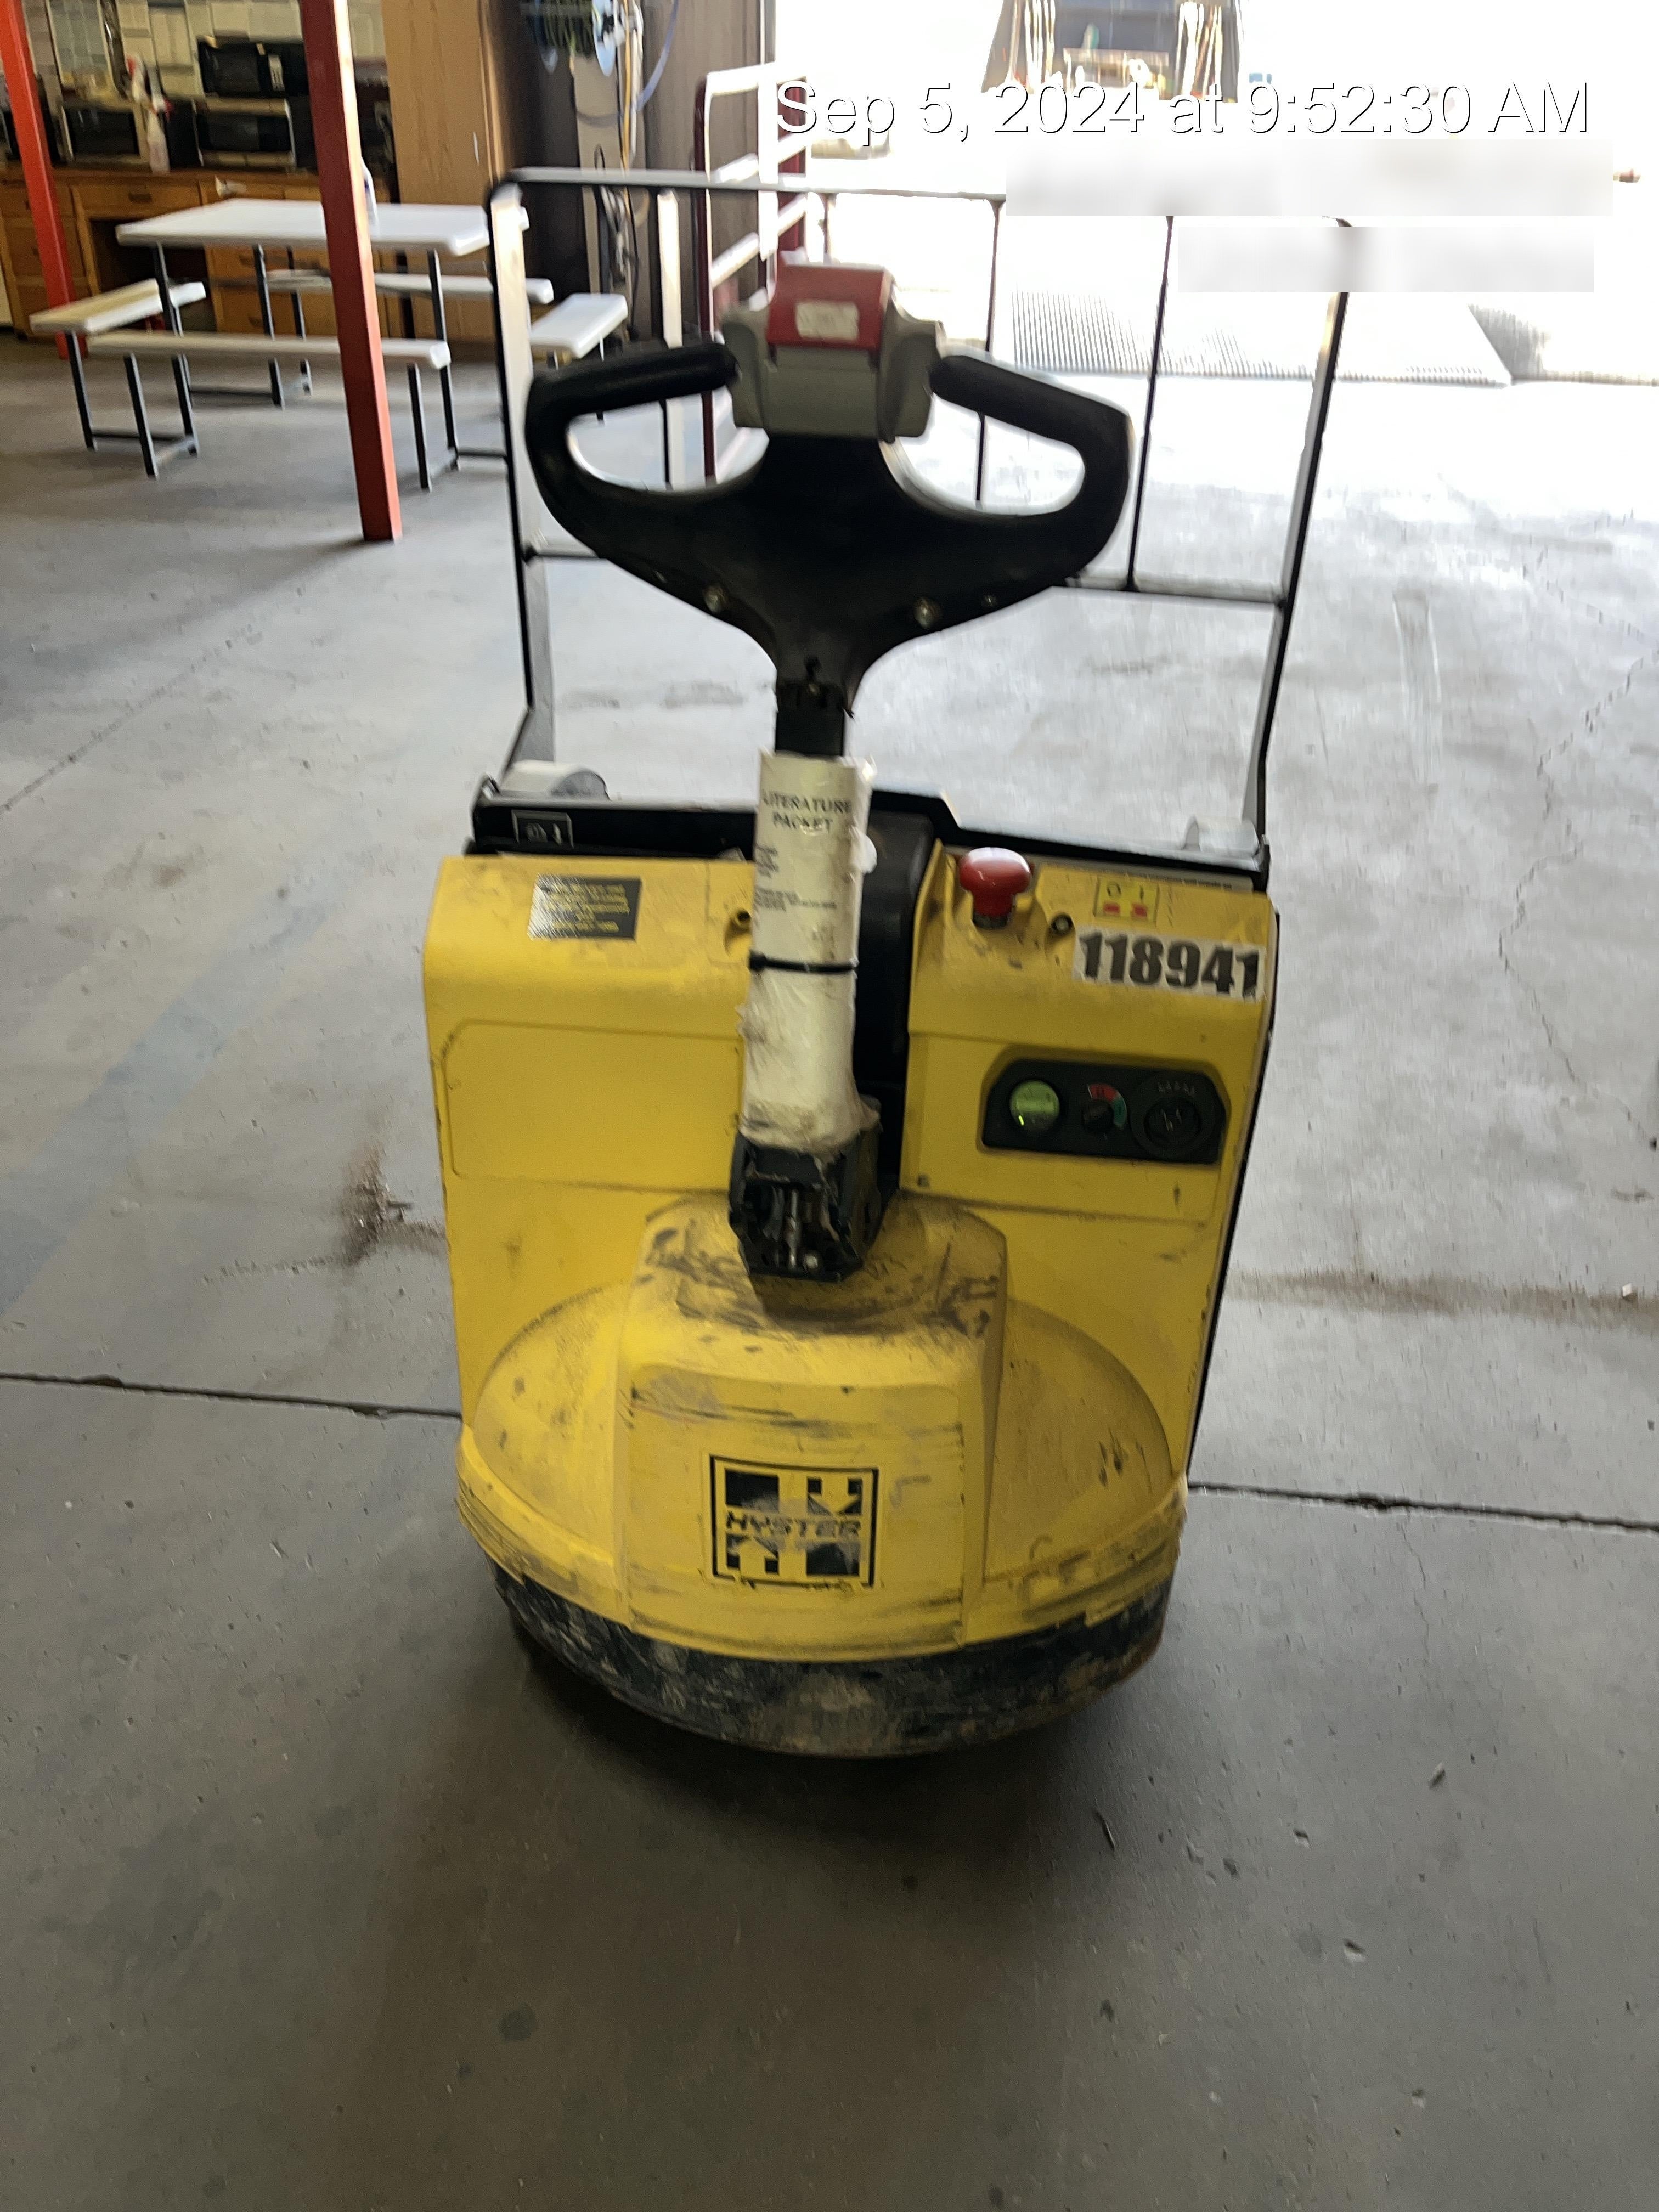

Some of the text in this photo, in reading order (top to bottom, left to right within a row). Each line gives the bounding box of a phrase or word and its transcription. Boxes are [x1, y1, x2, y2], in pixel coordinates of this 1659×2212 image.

[762, 789, 852, 813] LITERATURE
[772, 811, 833, 833] PACKET
[1079, 931, 1260, 999] 118941
[726, 1511, 861, 1538] HYSTER
